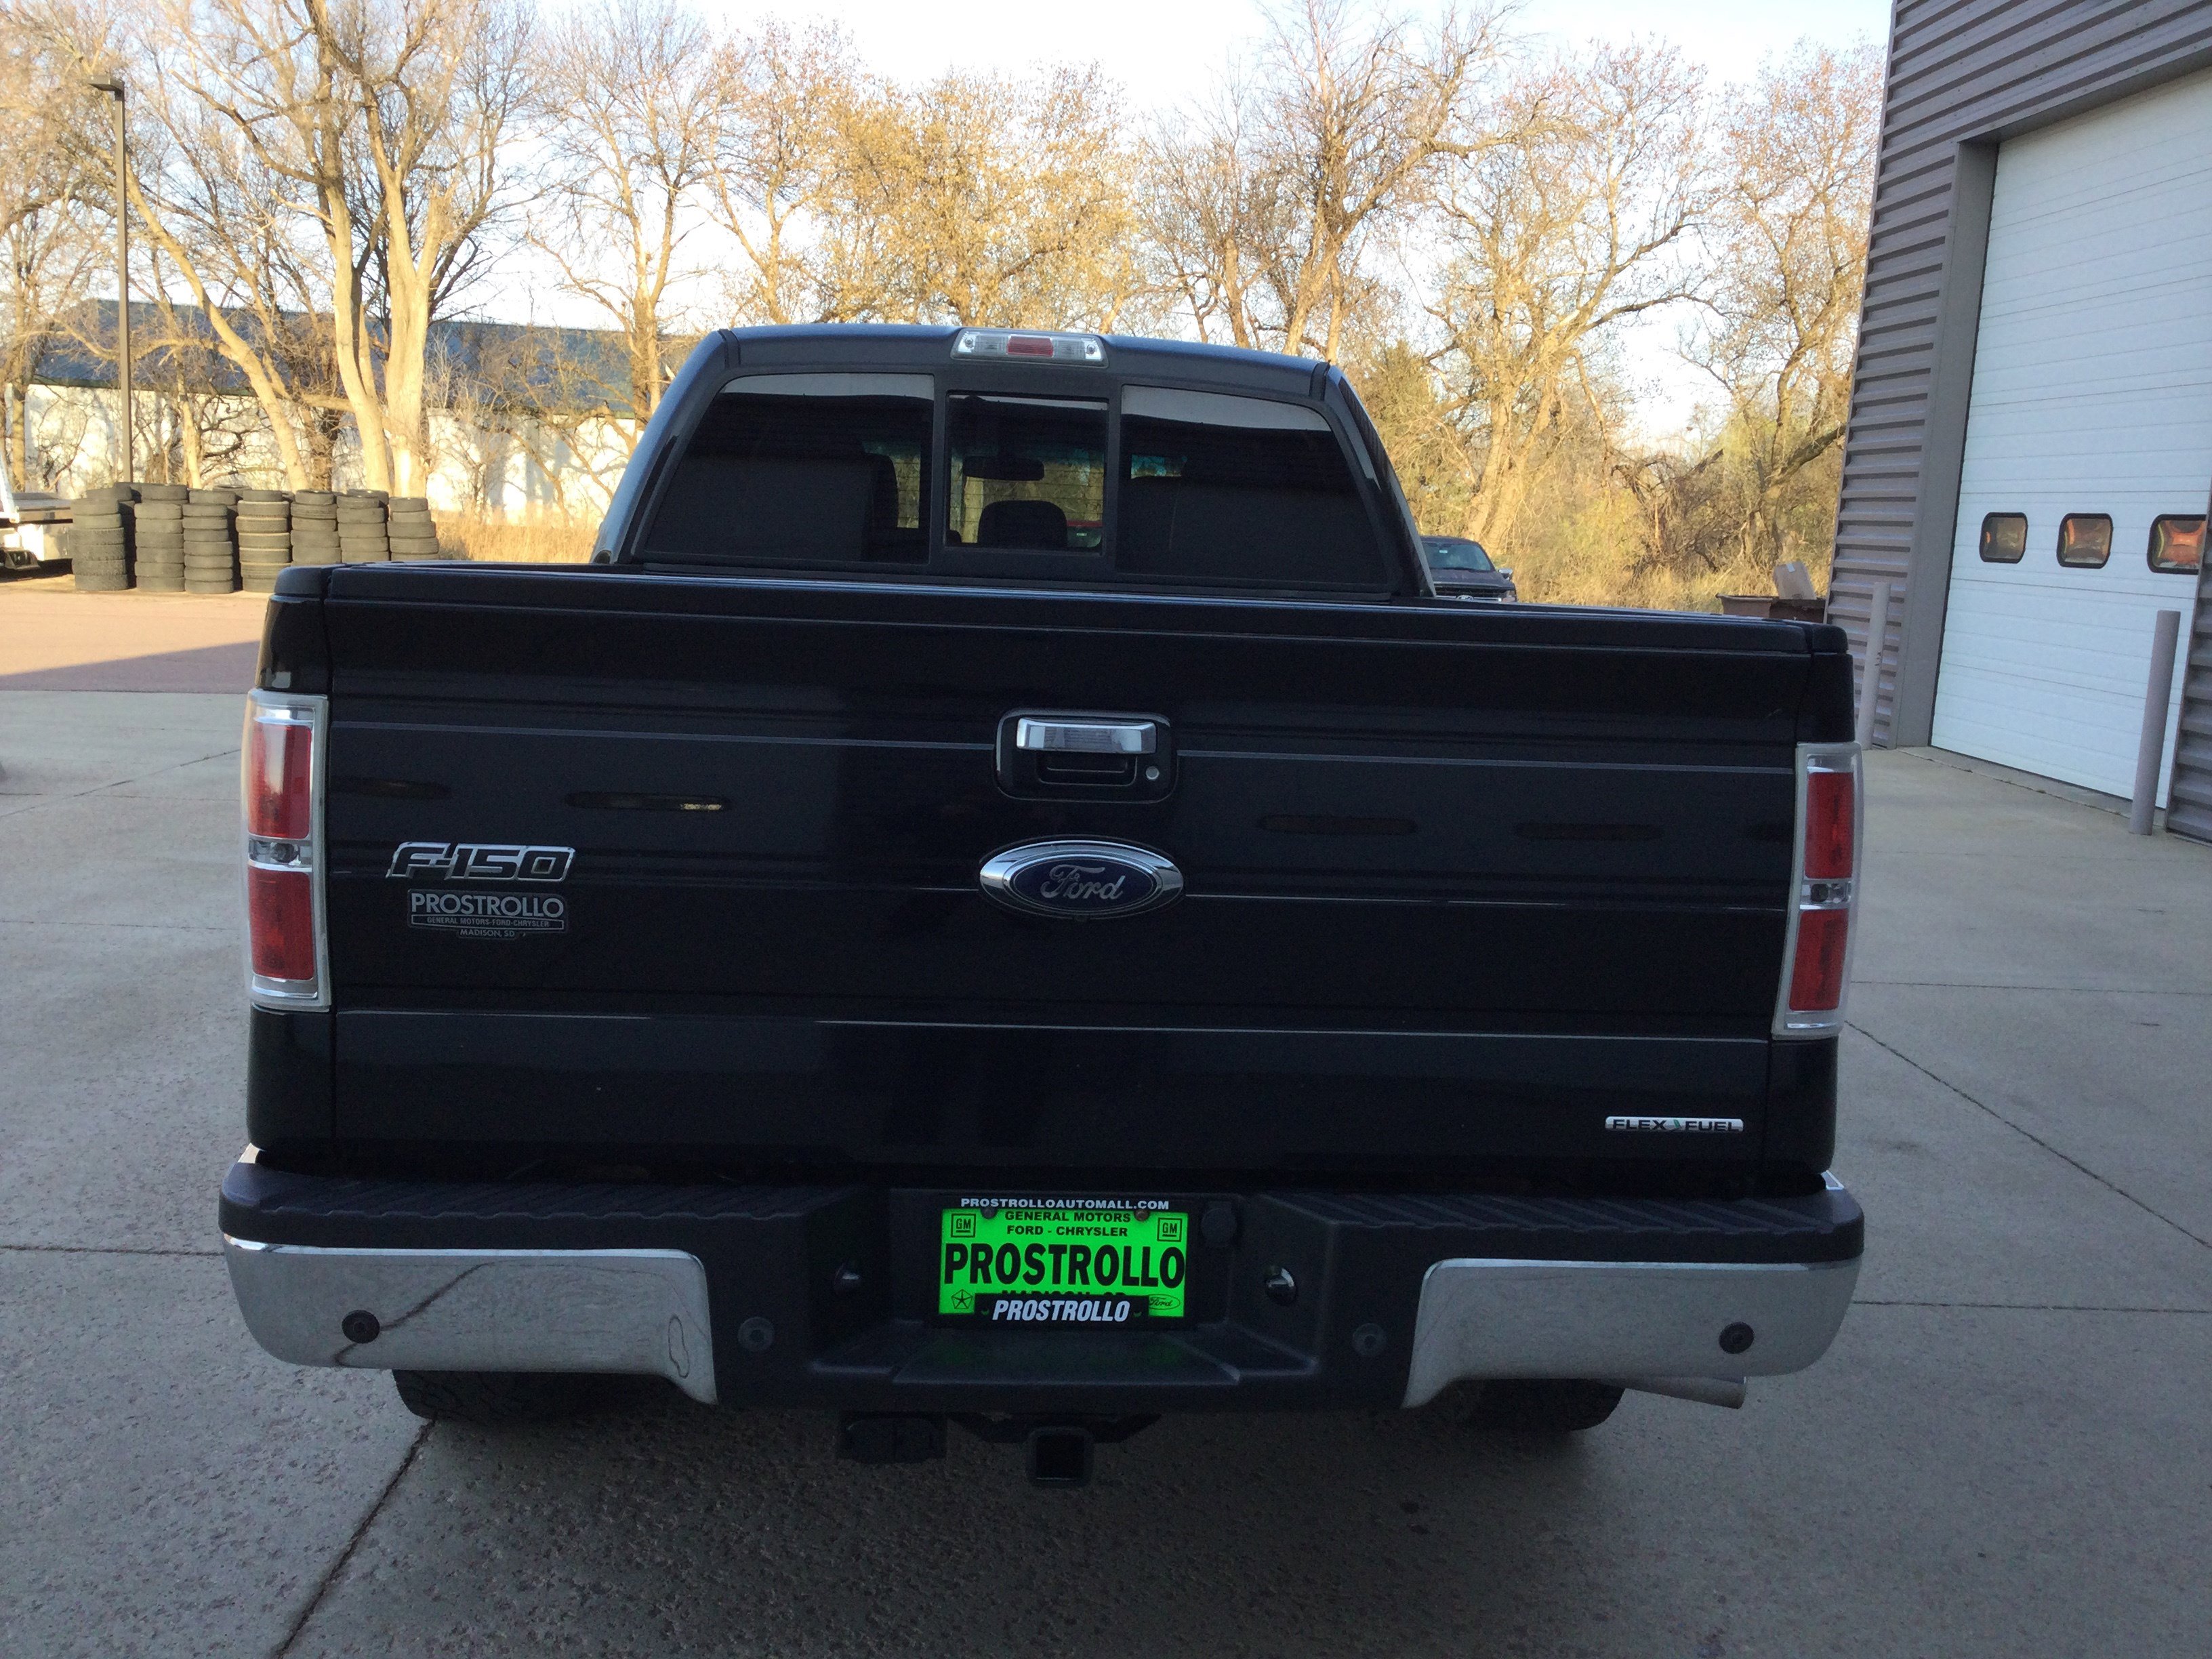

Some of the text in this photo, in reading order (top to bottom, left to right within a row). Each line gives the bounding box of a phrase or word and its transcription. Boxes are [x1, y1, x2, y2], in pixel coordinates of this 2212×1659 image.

[386, 841, 575, 881] F-150
[1040, 863, 1126, 900] Ford
[411, 893, 565, 918] PROSTROLLO
[1613, 1119, 1739, 1132] FLEX FUEL
[960, 1198, 1169, 1210] PROSTROLLOAUTOMALL.COM
[1004, 1211, 1131, 1223] GENERAL MOTORS
[956, 1221, 971, 1229] GM
[1006, 1225, 1044, 1235] FORD
[1056, 1227, 1128, 1237] CHRYSLER
[1162, 1224, 1177, 1233] GM
[945, 1242, 1185, 1288] PROSTROLLO
[1149, 1297, 1172, 1307] Ford
[992, 1299, 1130, 1322] PROSTROLLO
